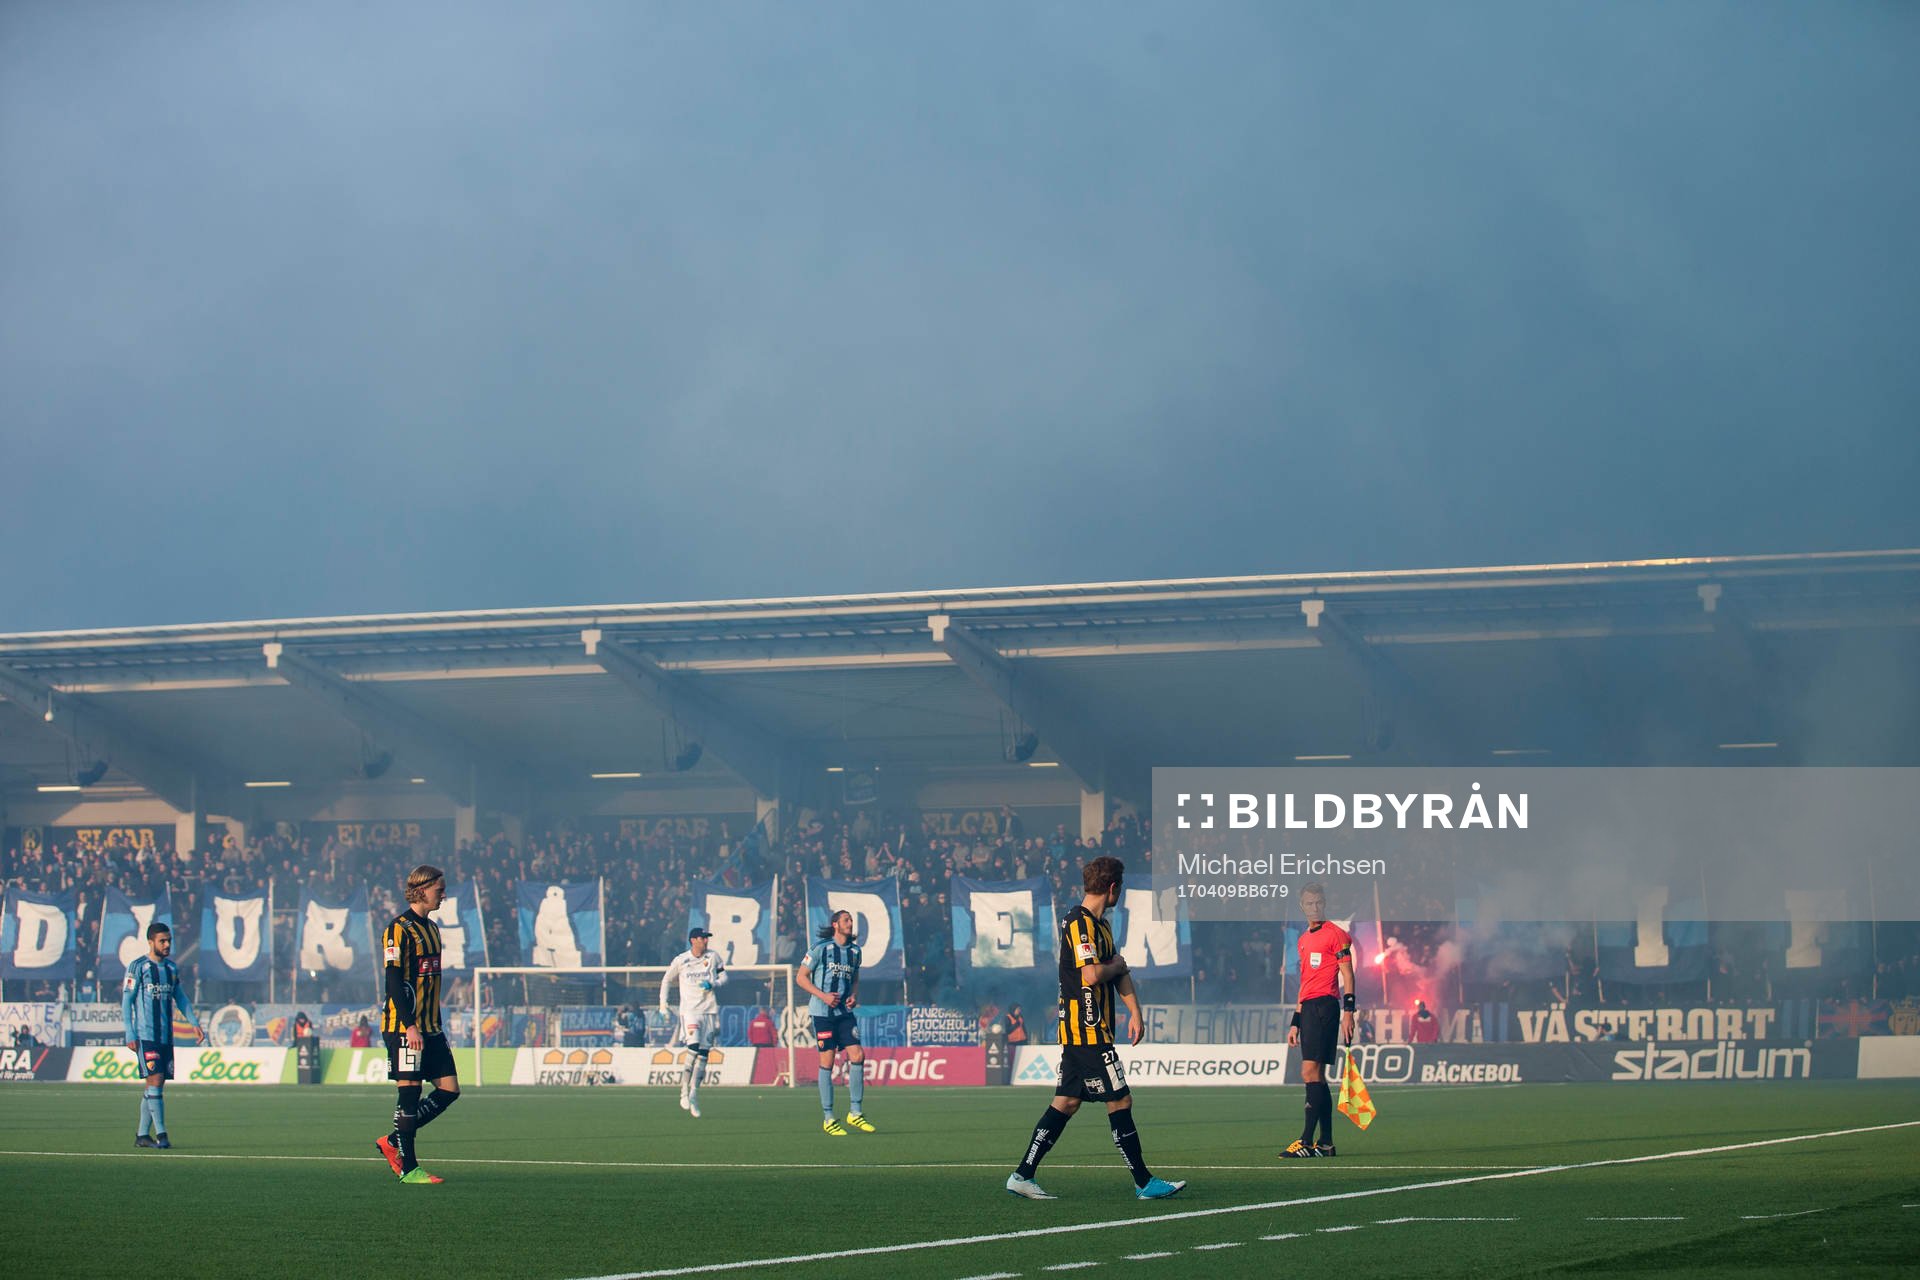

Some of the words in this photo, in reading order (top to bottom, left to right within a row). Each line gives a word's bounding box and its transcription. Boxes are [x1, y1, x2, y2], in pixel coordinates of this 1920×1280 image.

[1084, 992, 1094, 1022] BOHUS
[1517, 1002, 1775, 1043] VÄSTERORT
[190, 1050, 260, 1080] Leca
[1101, 1050, 1115, 1064] 27
[1421, 1060, 1523, 1083] BÄCKEBOL
[1611, 1037, 1811, 1081] stadium
[648, 1070, 721, 1085] EKSJUS
